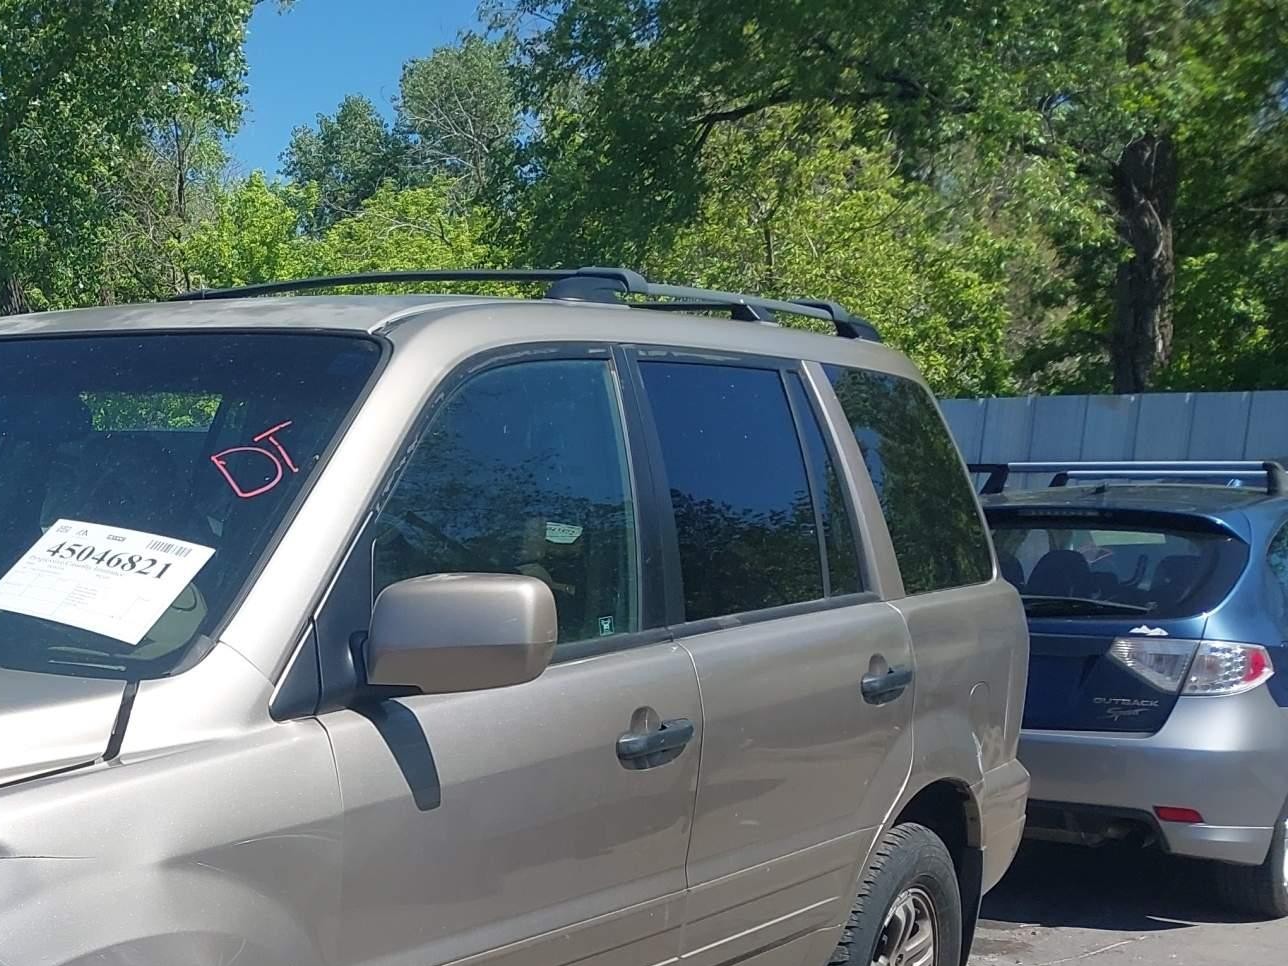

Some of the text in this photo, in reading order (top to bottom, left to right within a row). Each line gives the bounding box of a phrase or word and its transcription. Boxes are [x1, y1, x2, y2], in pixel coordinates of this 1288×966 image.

[210, 420, 299, 498] DT
[46, 540, 173, 579] 45046821
[1093, 697, 1159, 707] OUTBACK
